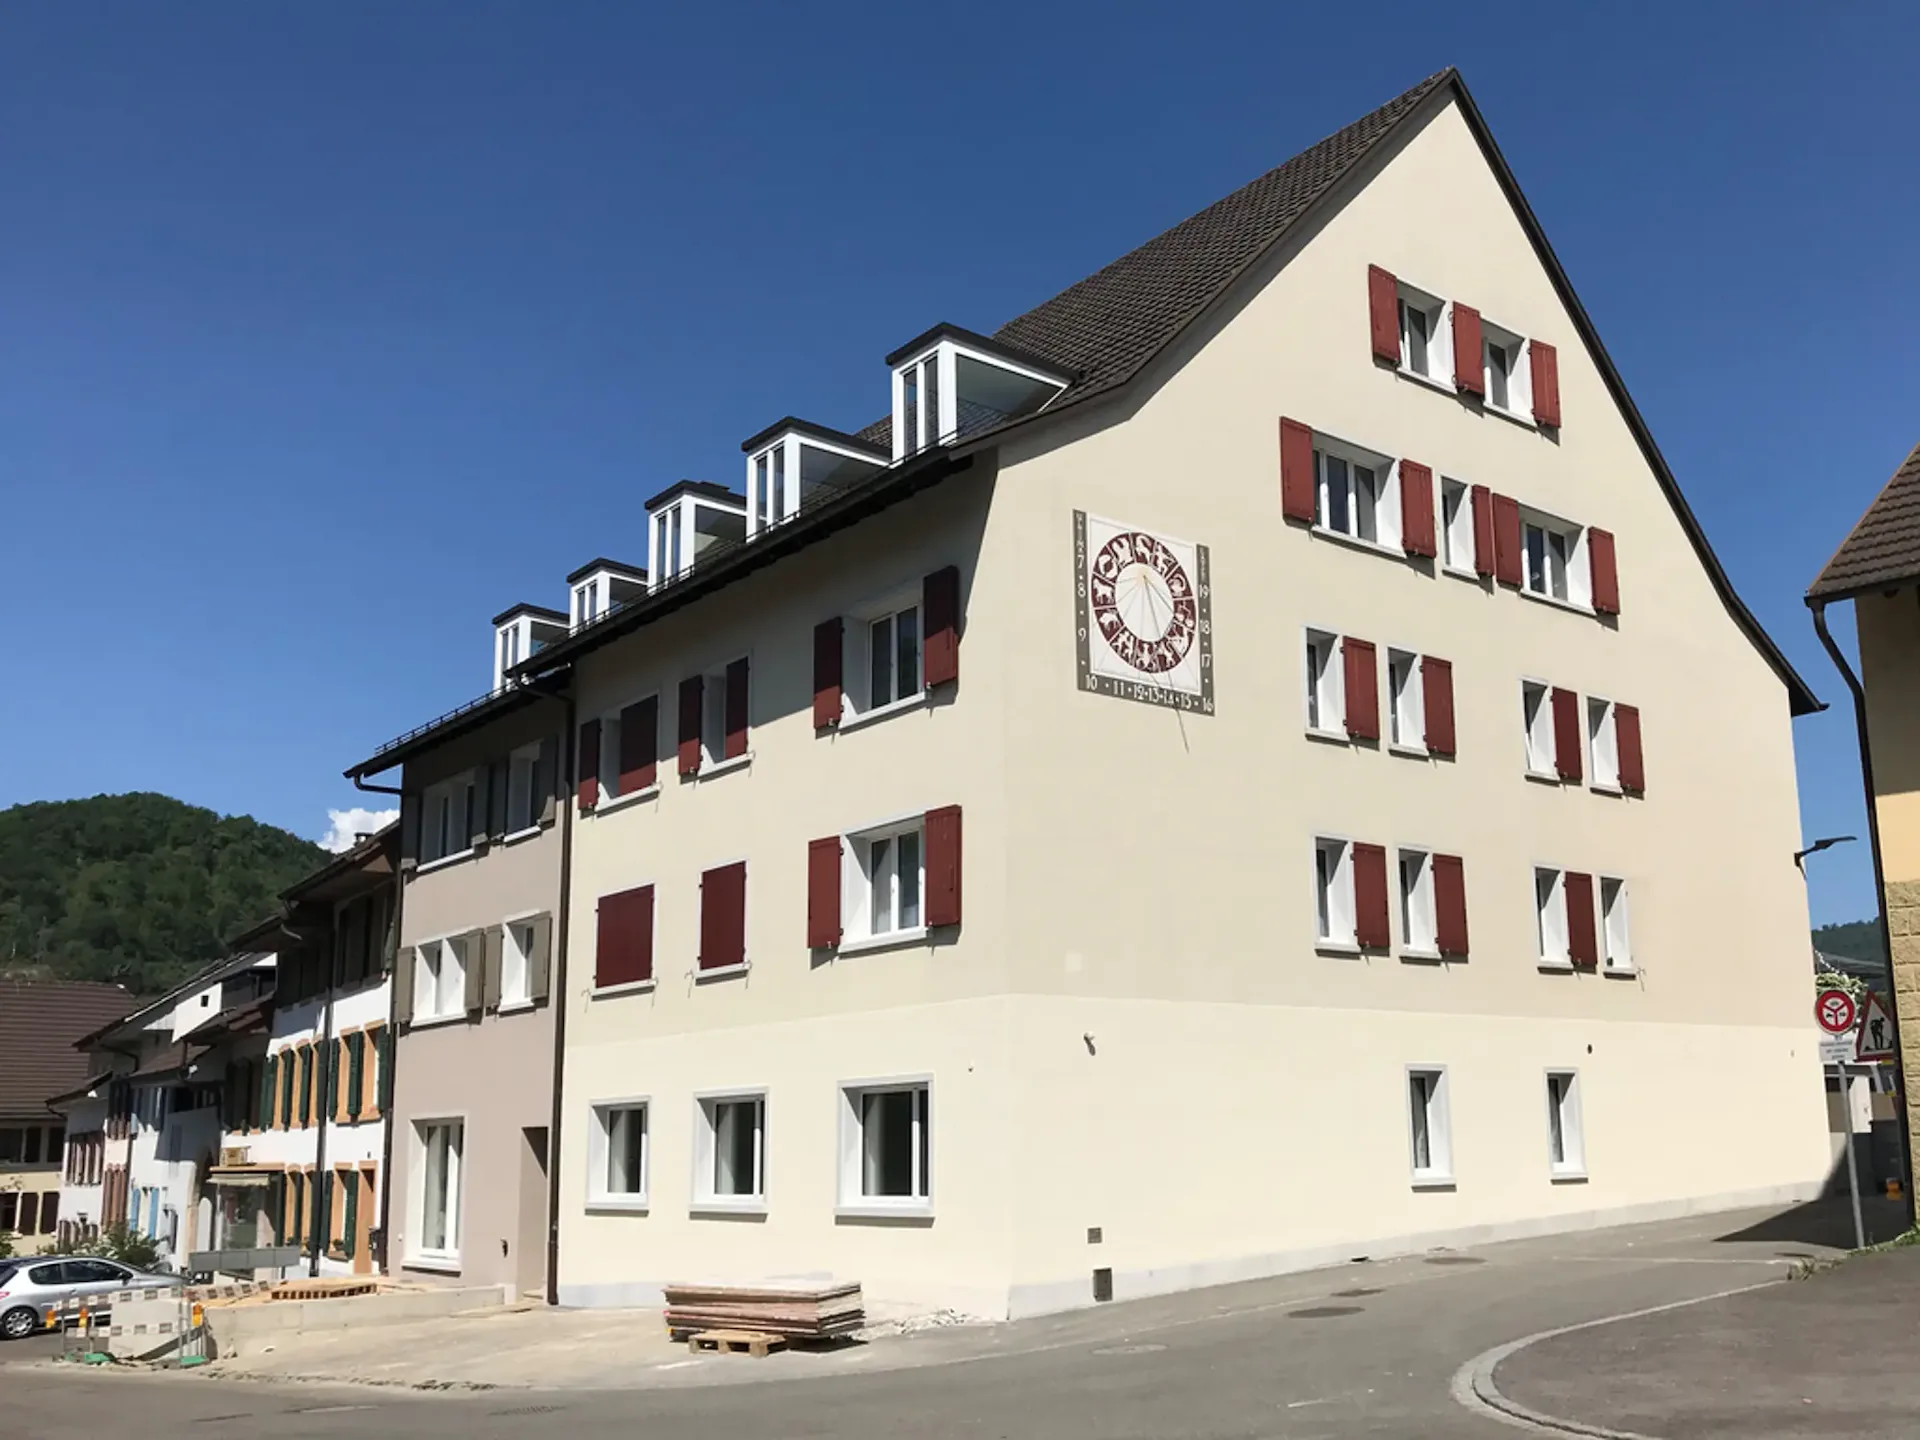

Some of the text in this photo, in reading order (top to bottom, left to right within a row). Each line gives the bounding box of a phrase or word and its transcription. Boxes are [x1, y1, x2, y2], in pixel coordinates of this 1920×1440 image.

[1077, 554, 1085, 569] 7
[1077, 582, 1086, 598] 8
[1199, 584, 1209, 599] 19
[1077, 627, 1087, 642] 9
[1199, 620, 1210, 635] 18
[1201, 653, 1211, 668] 17
[1085, 675, 1214, 712] 10 11 12 13 14 15 16
